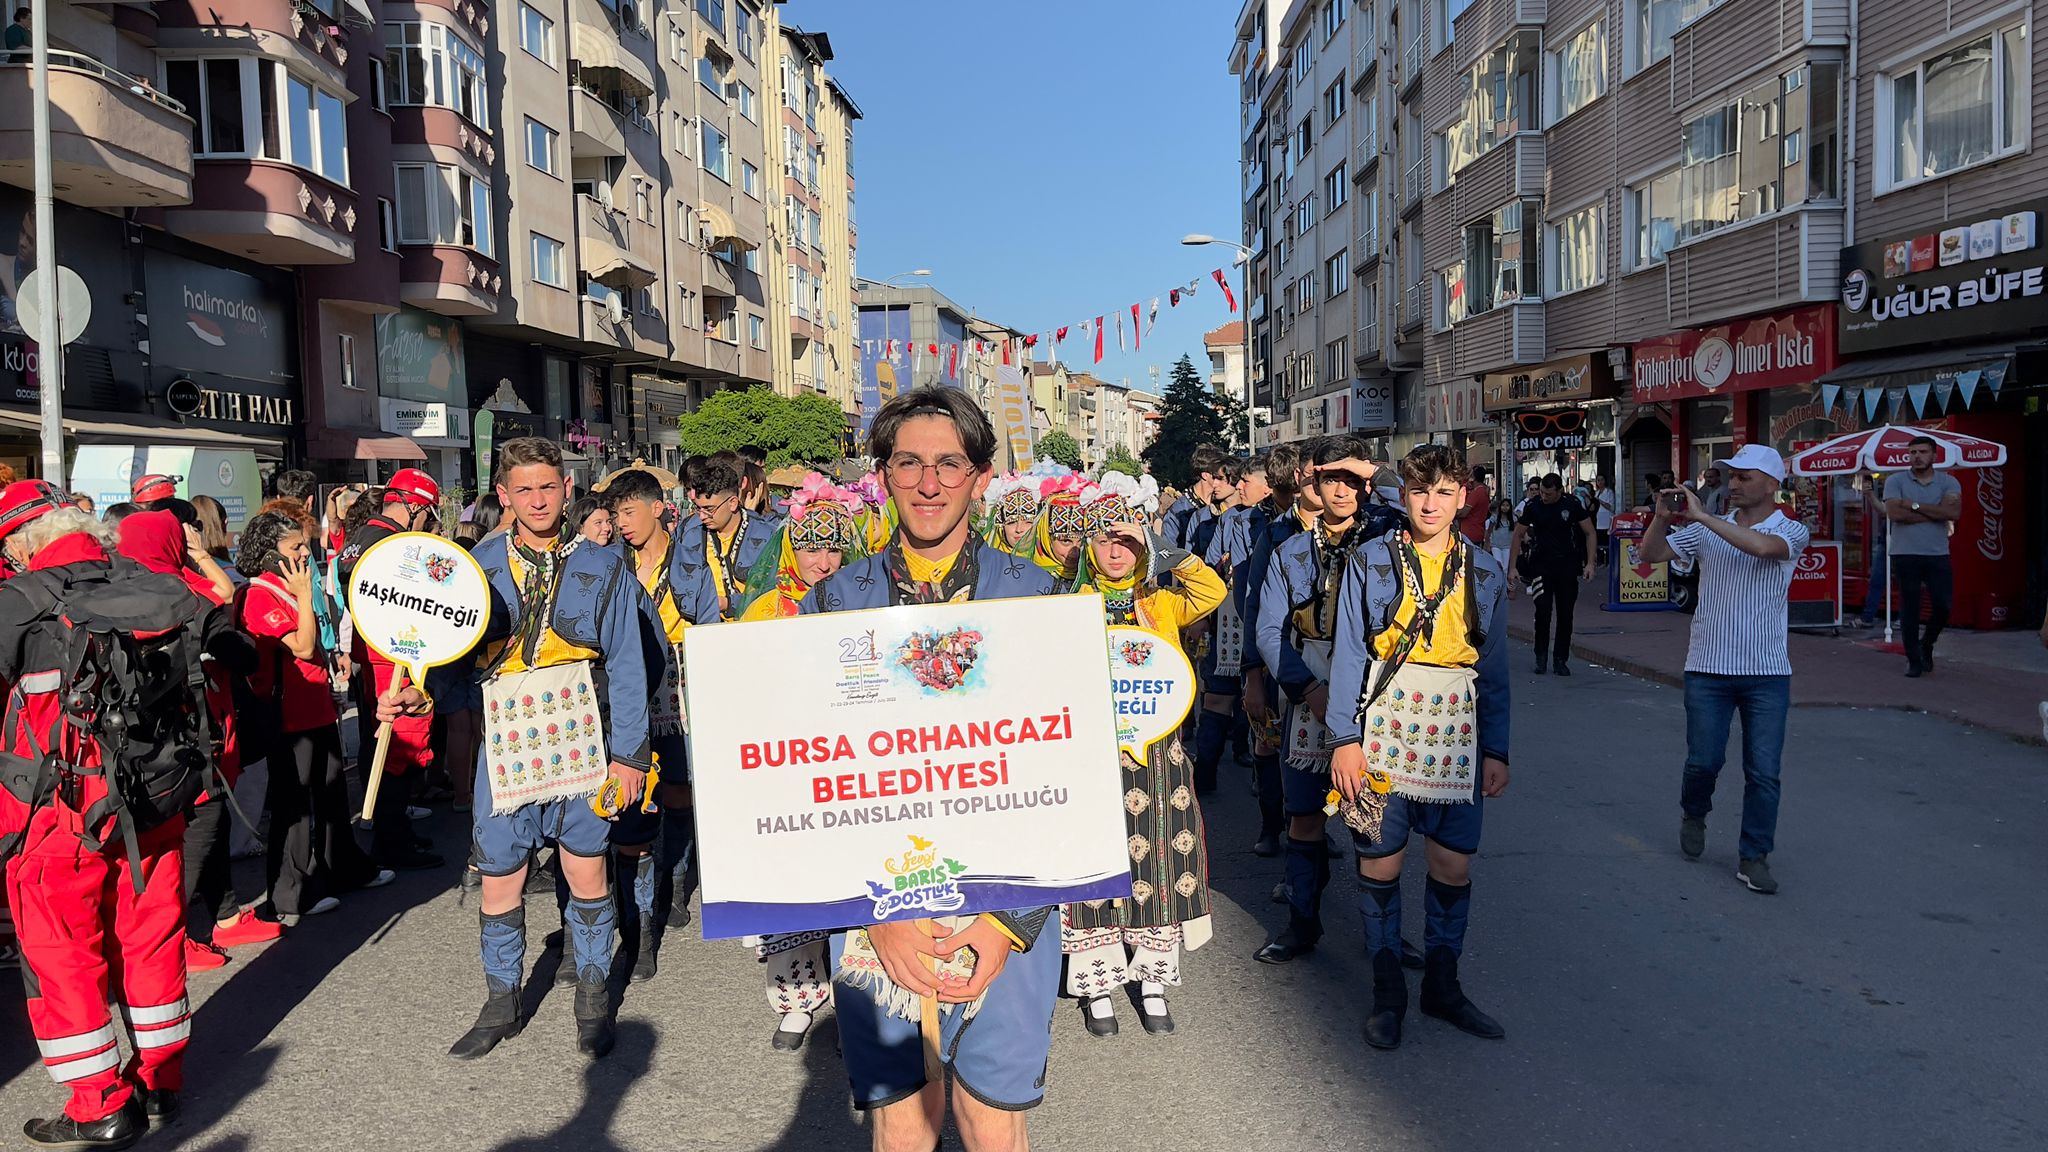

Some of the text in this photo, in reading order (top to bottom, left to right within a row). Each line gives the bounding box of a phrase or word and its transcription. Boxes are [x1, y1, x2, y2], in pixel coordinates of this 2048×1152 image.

[184, 284, 257, 323] halimarka
[1871, 266, 2044, 321] UĞUR BÜFE
[1735, 335, 1774, 375] Ömer
[1776, 330, 1814, 369] Usta
[1356, 386, 1390, 400] KOÇ
[396, 408, 439, 419] EMİNEVİM
[1520, 432, 1583, 450] BN OPTİK
[1886, 453, 1912, 464] ALG
[1621, 580, 1668, 589] YÜKLEME
[1622, 591, 1666, 600] NOKTASI
[358, 579, 479, 628] #AşkımEreğli
[1114, 696, 1157, 715] EĞLİ
[740, 706, 1073, 770] BURSA ORHANGAZİ
[812, 752, 1009, 804] BELEDİYESİ
[756, 784, 1069, 835] HALK DANSLARI TOPLULUĞU
[885, 848, 937, 876] Sevgi
[894, 865, 947, 892] BARIŞ
[888, 882, 955, 909] DOSTLUK
